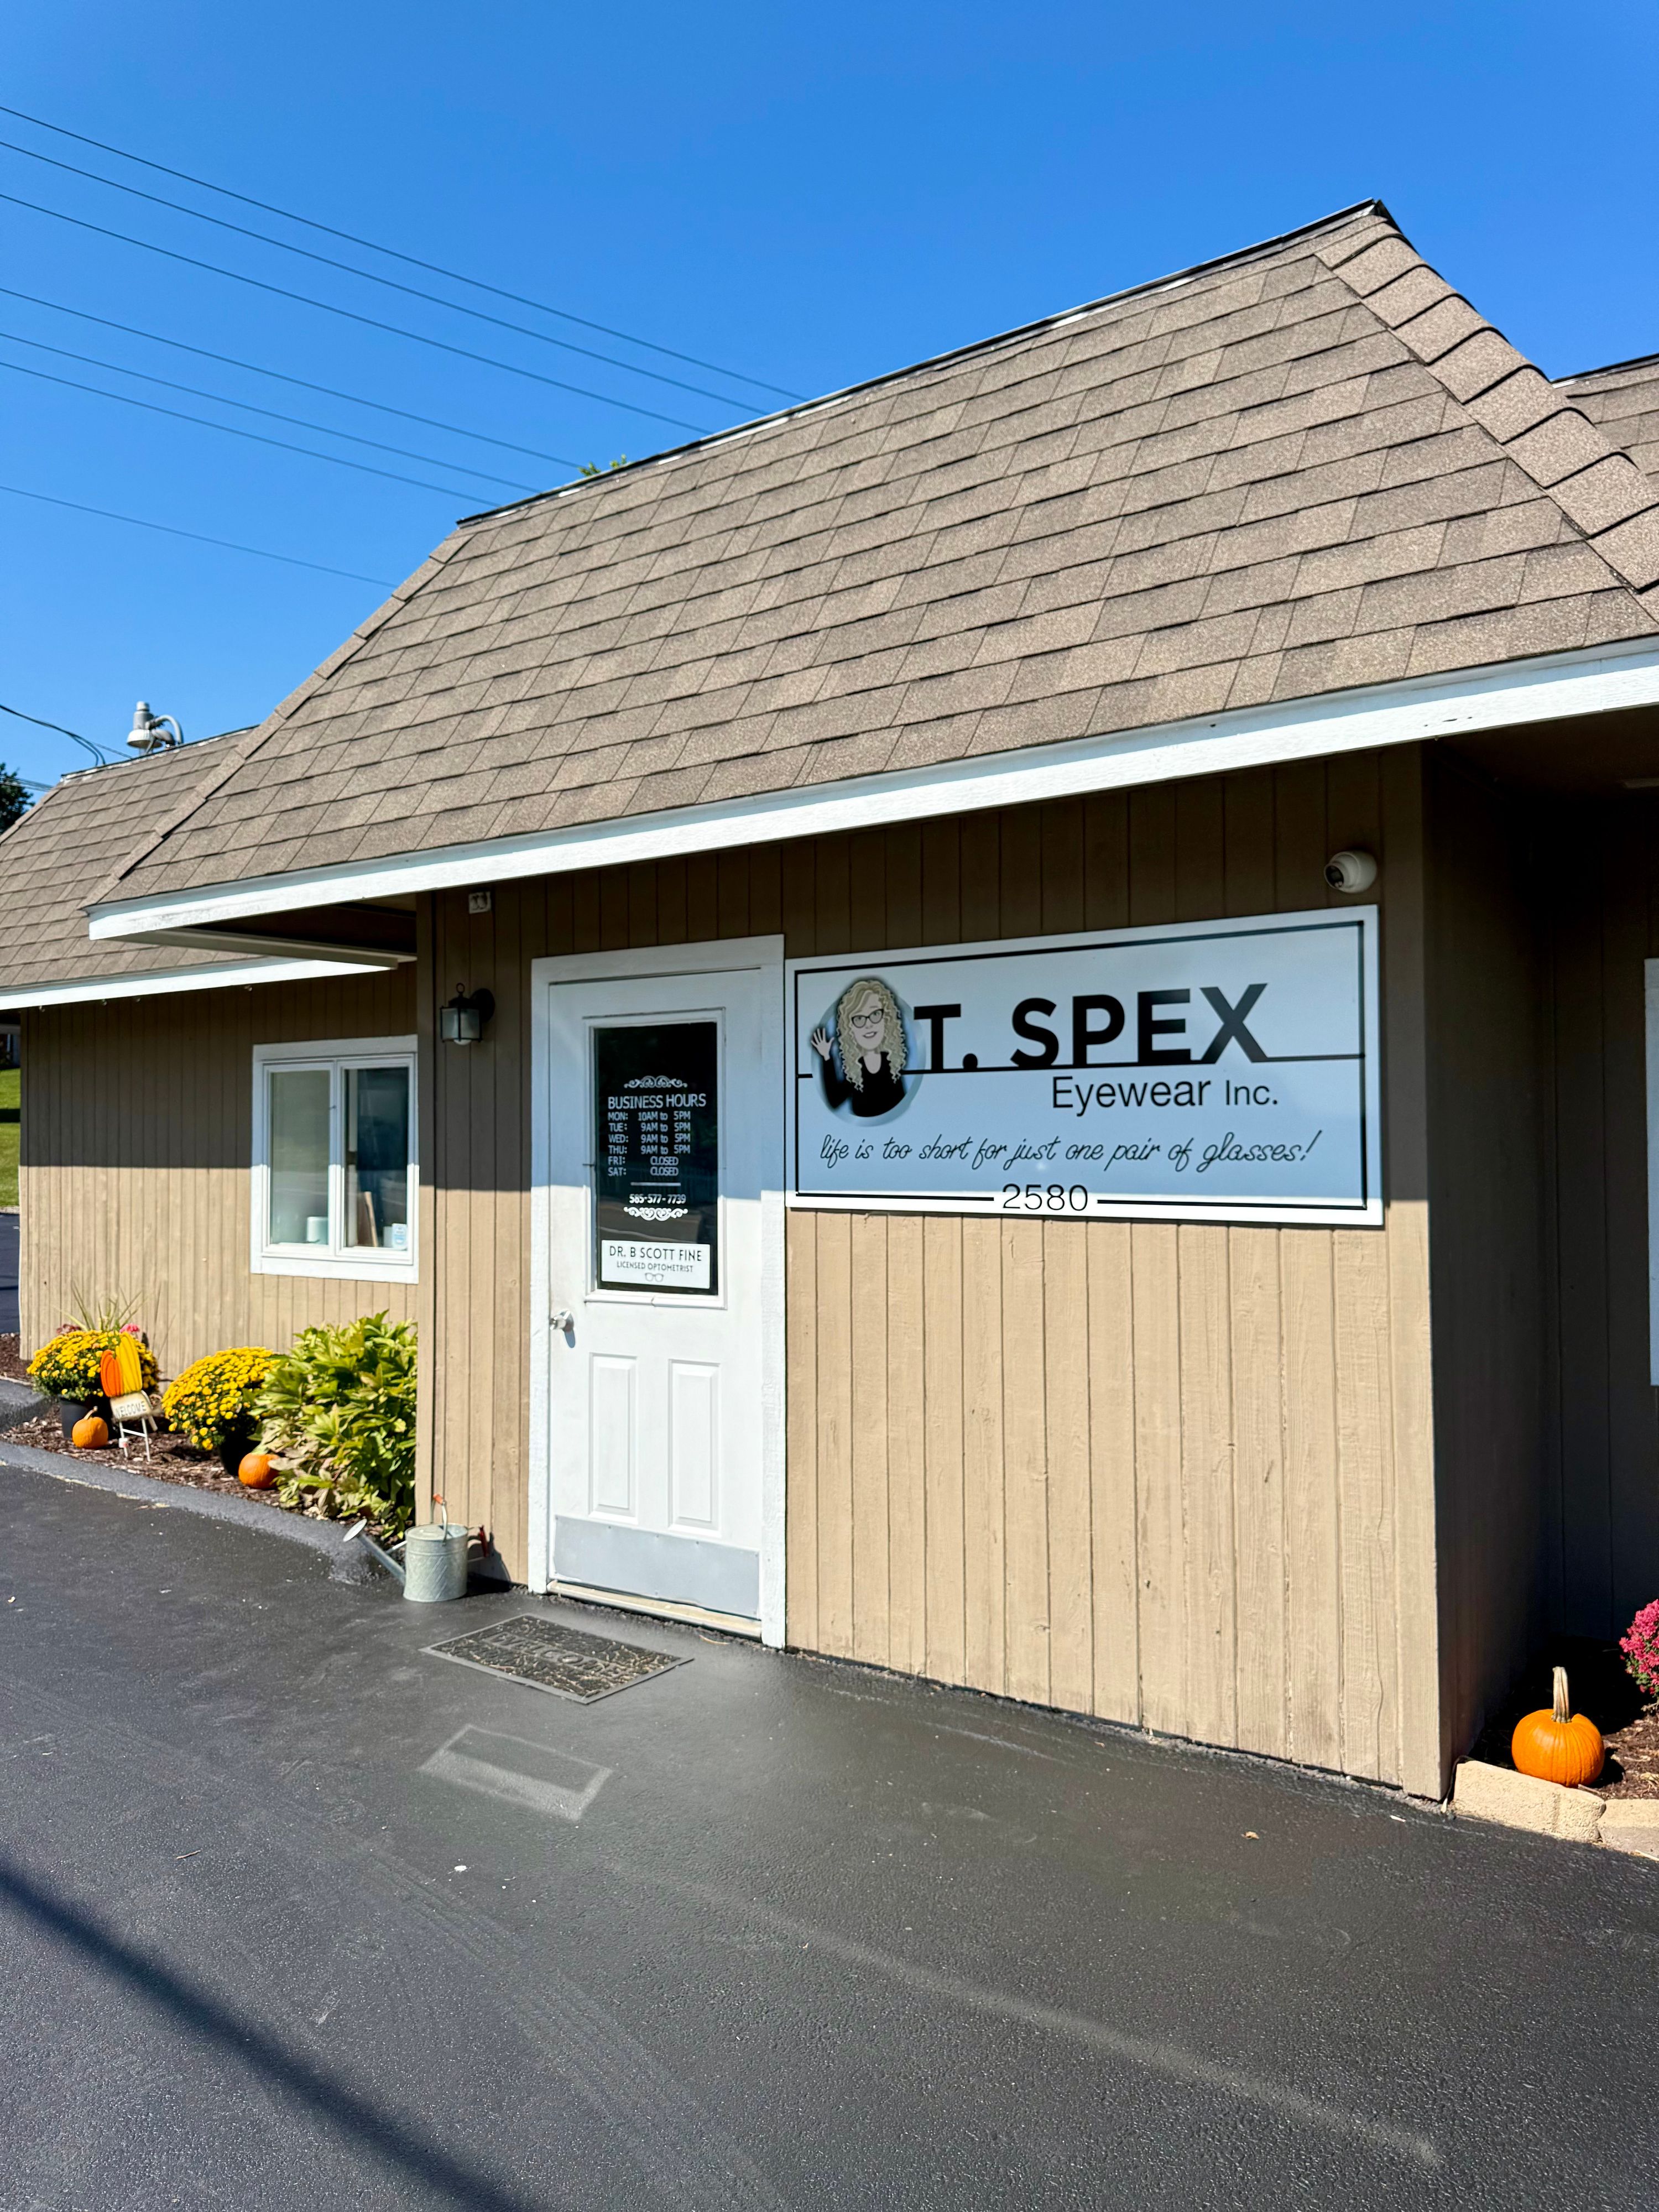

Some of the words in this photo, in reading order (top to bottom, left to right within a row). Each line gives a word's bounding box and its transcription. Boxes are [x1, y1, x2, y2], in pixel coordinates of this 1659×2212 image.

[914, 1003, 978, 1070] T.
[1010, 983, 1268, 1068] SPEX
[608, 1095, 664, 1109] BUSINESS
[666, 1093, 707, 1107] HOURS
[1052, 1076, 1211, 1117] Eyewear
[1225, 1079, 1278, 1107] Inc.
[607, 1111, 628, 1121] MON:
[638, 1111, 658, 1121] 10AM
[660, 1112, 668, 1121] to
[673, 1110, 691, 1120] 5PM
[608, 1123, 628, 1132] TUE:
[640, 1122, 658, 1132] 9AM
[660, 1123, 668, 1132] to
[674, 1122, 691, 1131] 5PM
[608, 1134, 629, 1144] WED:
[640, 1134, 658, 1144] 9AM
[660, 1134, 669, 1143] to
[674, 1133, 691, 1142] 5PM
[608, 1145, 628, 1155] THU:
[640, 1145, 658, 1155] 9AM
[660, 1146, 669, 1155] to
[674, 1144, 691, 1154] 5PM
[820, 1134, 849, 1168] life
[855, 1139, 874, 1159] is
[883, 1137, 912, 1159] too
[919, 1134, 973, 1160] short
[972, 1138, 1007, 1170] for
[1003, 1135, 1061, 1171] just
[1065, 1144, 1104, 1161] one
[1104, 1137, 1161, 1172] pair
[1168, 1137, 1194, 1172] of
[1196, 1129, 1323, 1173] glasses!
[608, 1156, 625, 1165] FRI:
[650, 1156, 679, 1166] CLOSED
[608, 1167, 627, 1176] SAT:
[650, 1166, 679, 1176] CLOSED
[1002, 1183, 1088, 1211] 2580
[609, 1246, 626, 1258] DR.
[630, 1247, 636, 1258] B
[640, 1248, 675, 1260] SCOTT
[679, 1250, 702, 1261] FINE
[617, 1261, 645, 1270] LICENSED
[648, 1262, 693, 1272] OPTOMETRIST
